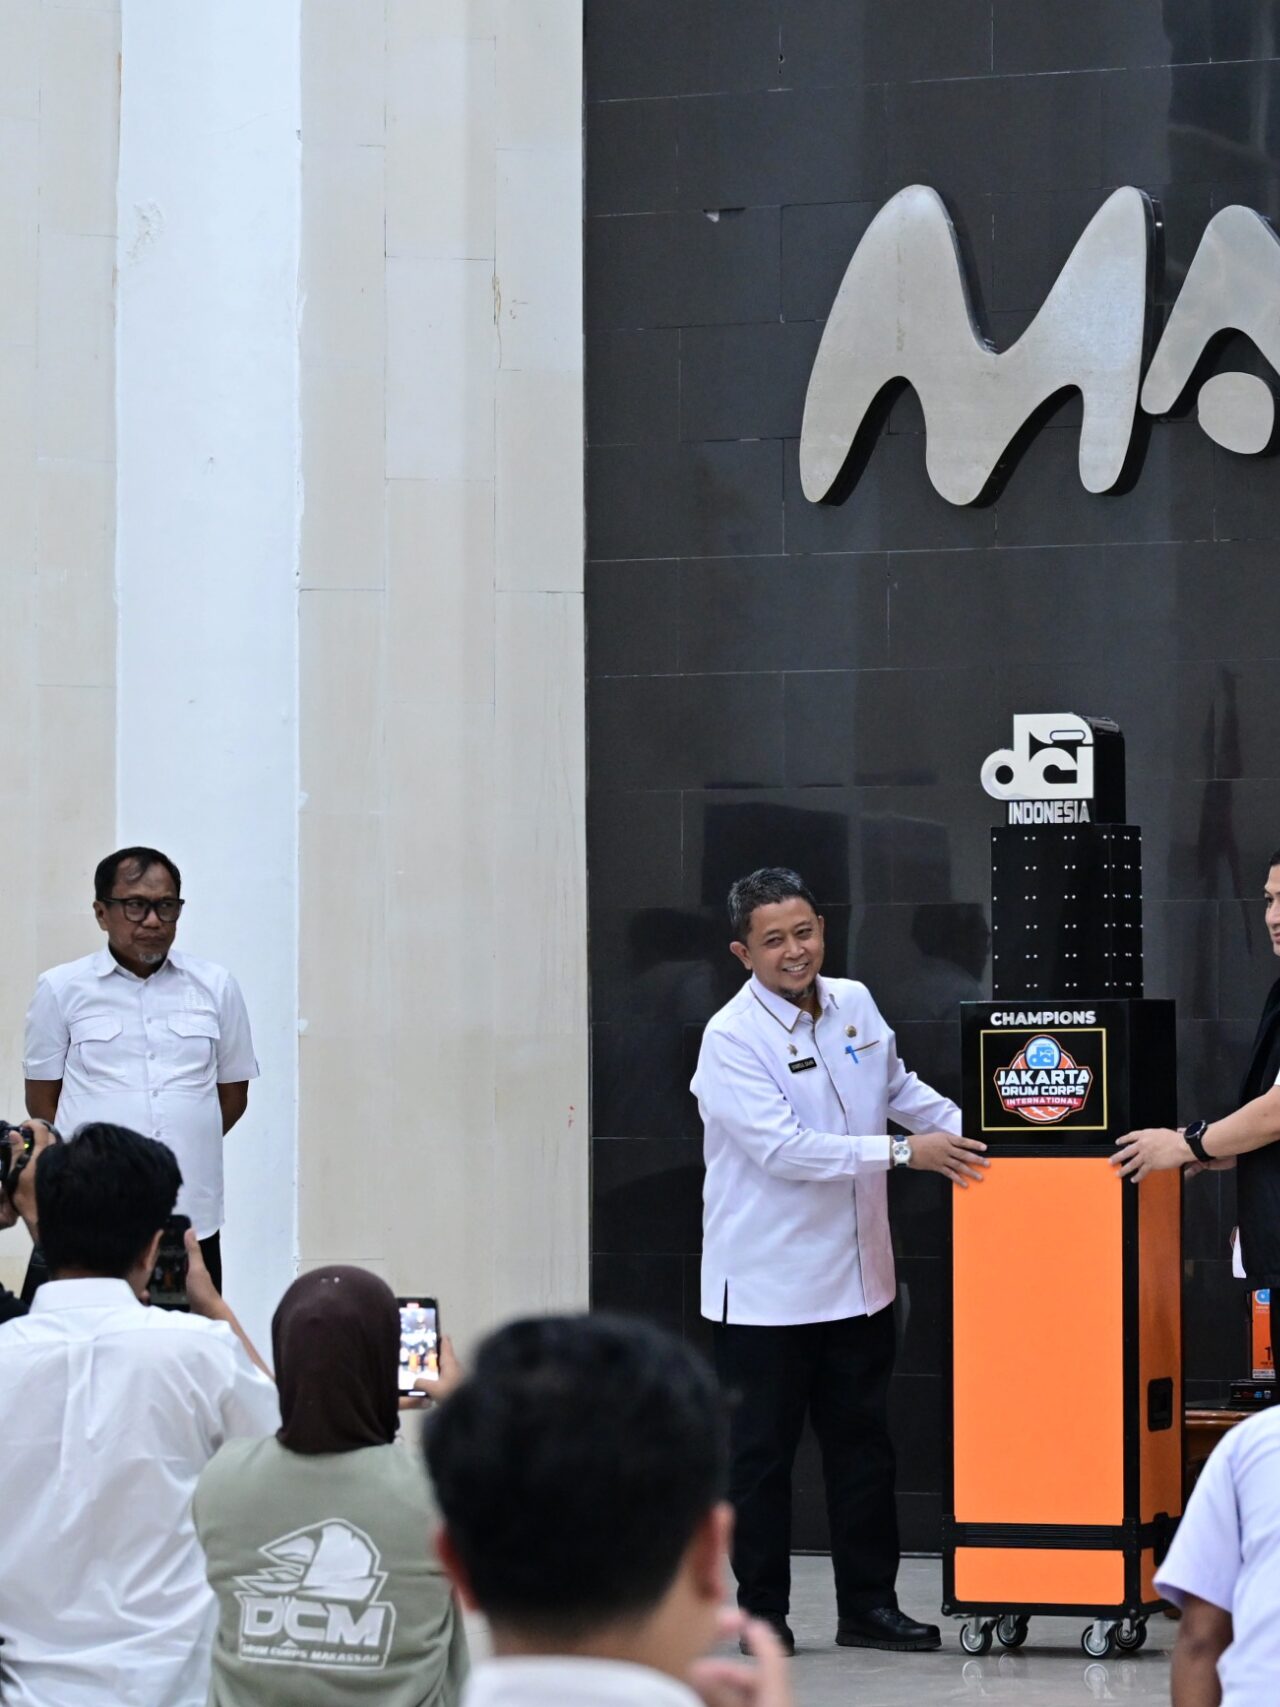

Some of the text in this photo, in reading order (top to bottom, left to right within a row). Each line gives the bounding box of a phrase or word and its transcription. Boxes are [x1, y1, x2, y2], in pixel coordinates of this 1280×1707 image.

[1008, 800, 1090, 825] INDONESIA
[990, 1010, 1097, 1027] CHAMPIONS
[997, 1069, 1090, 1086] JAKARTA
[1001, 1085, 1085, 1096] DRUM CORPS
[1006, 1097, 1079, 1106] INTERNATIONAL
[244, 1596, 386, 1647] DCM
